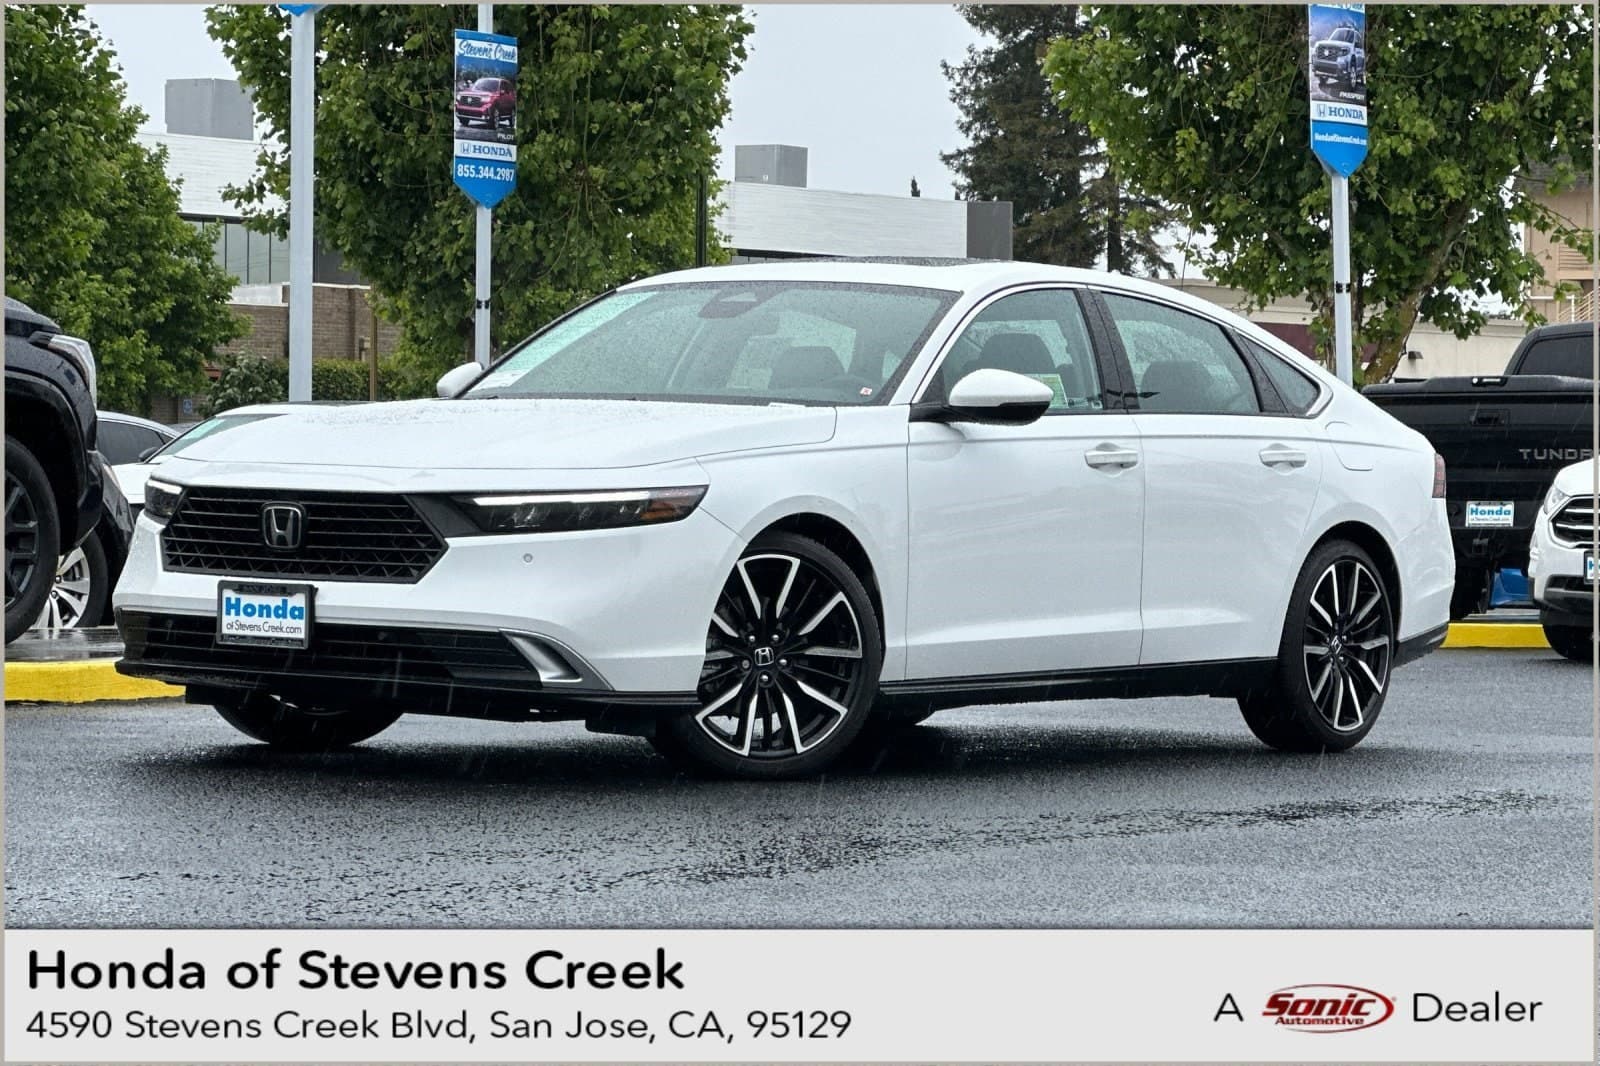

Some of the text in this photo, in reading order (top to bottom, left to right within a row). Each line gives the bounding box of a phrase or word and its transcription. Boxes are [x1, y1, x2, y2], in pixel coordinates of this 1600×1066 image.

[458, 40, 493, 58] Stevens
[1328, 107, 1364, 120] HONDA
[497, 133, 514, 141] PILOT
[472, 144, 513, 158] HONDA
[457, 163, 515, 182] 855.344.2987
[1519, 449, 1594, 460] TUNDR
[1470, 507, 1511, 516] Honda
[225, 597, 304, 620] Honda
[226, 621, 234, 631] of
[235, 619, 262, 632] Stevens
